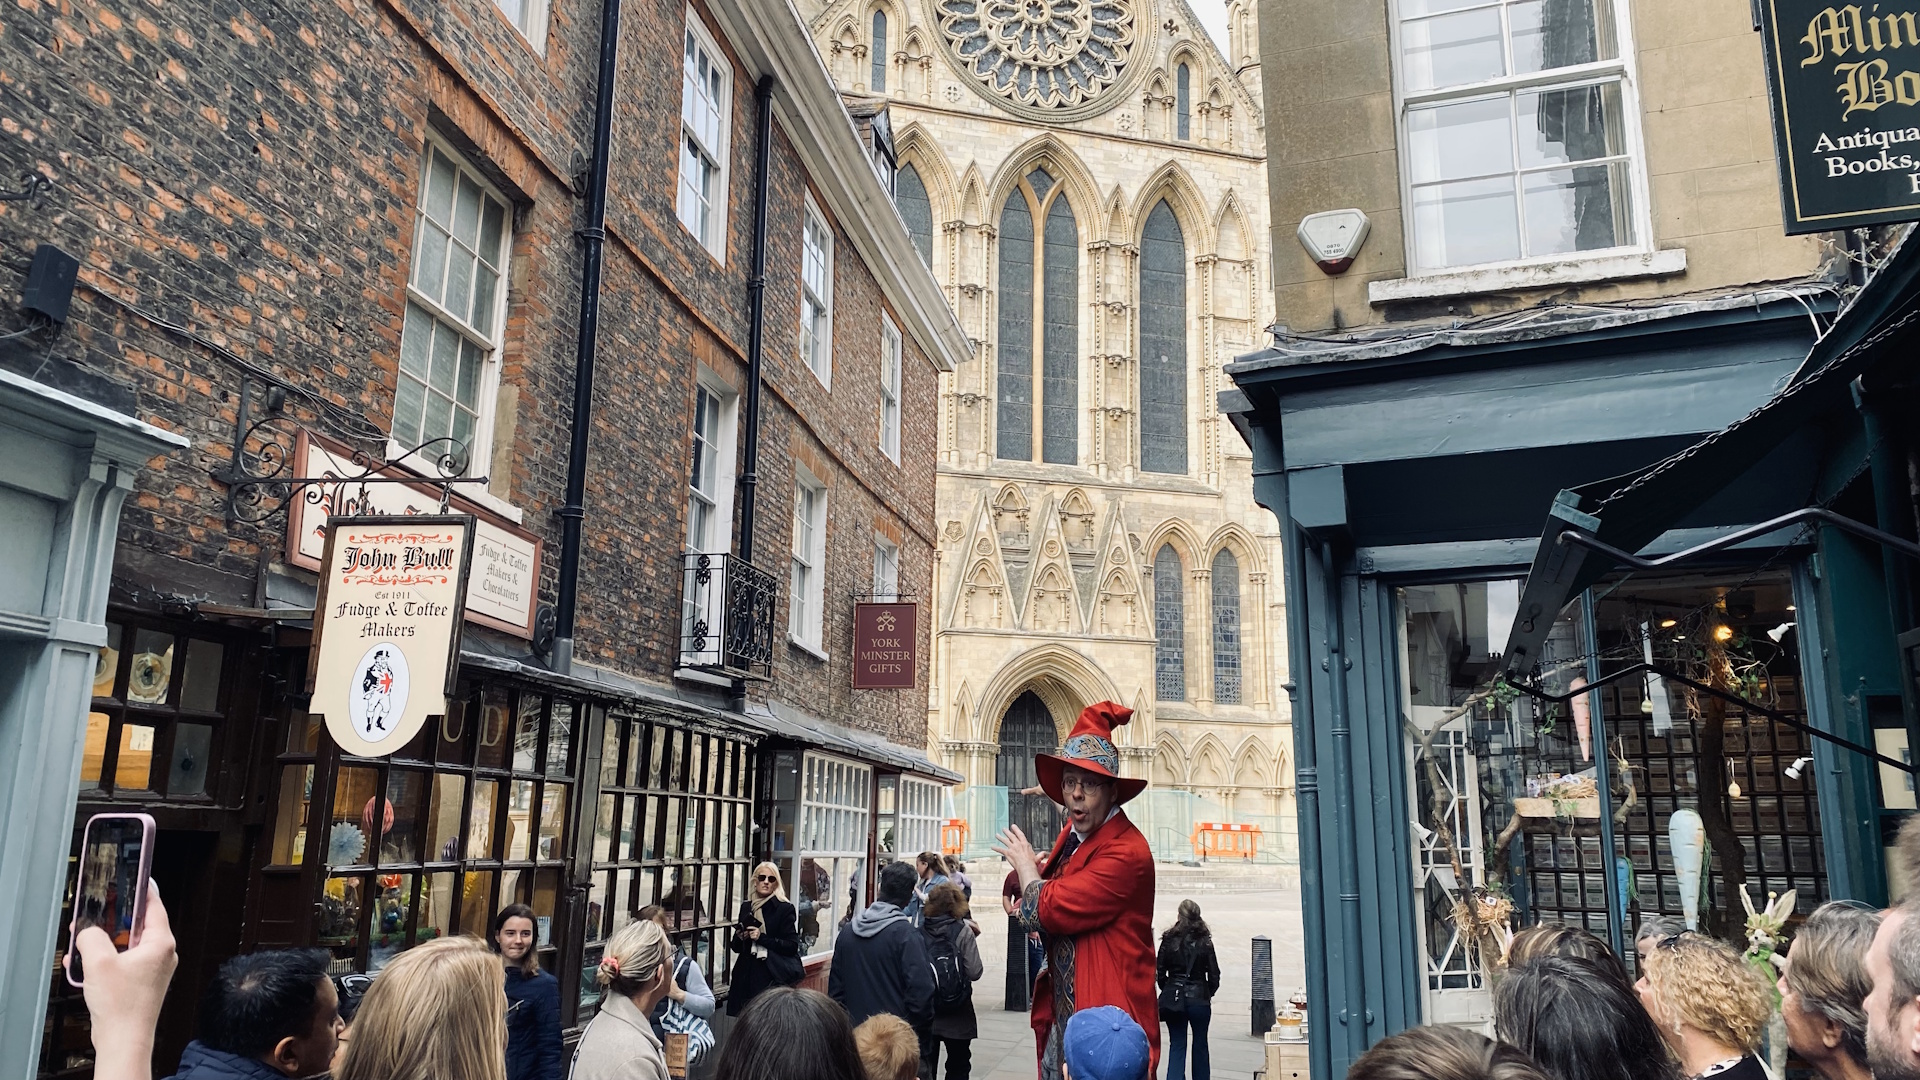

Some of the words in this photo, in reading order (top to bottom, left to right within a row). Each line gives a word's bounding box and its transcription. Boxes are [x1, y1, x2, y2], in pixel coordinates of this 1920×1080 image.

[1812, 126, 1920, 154] Antiqua
[1825, 150, 1920, 178] Books,
[341, 546, 397, 574] John
[402, 546, 454, 573] Bull
[479, 544, 500, 562] Fudge
[501, 552, 508, 564] &
[509, 555, 528, 573] Toffee
[486, 563, 511, 582] Makers
[512, 573, 518, 585] &
[374, 591, 389, 599] Est
[392, 591, 410, 599] 1911
[334, 601, 380, 619] Fudge
[385, 601, 398, 616] &
[404, 602, 448, 616] Toffee
[360, 621, 416, 638] Makers
[871, 638, 901, 647] YORK
[860, 651, 911, 661] MINSTER
[869, 663, 902, 673] GIFTS
